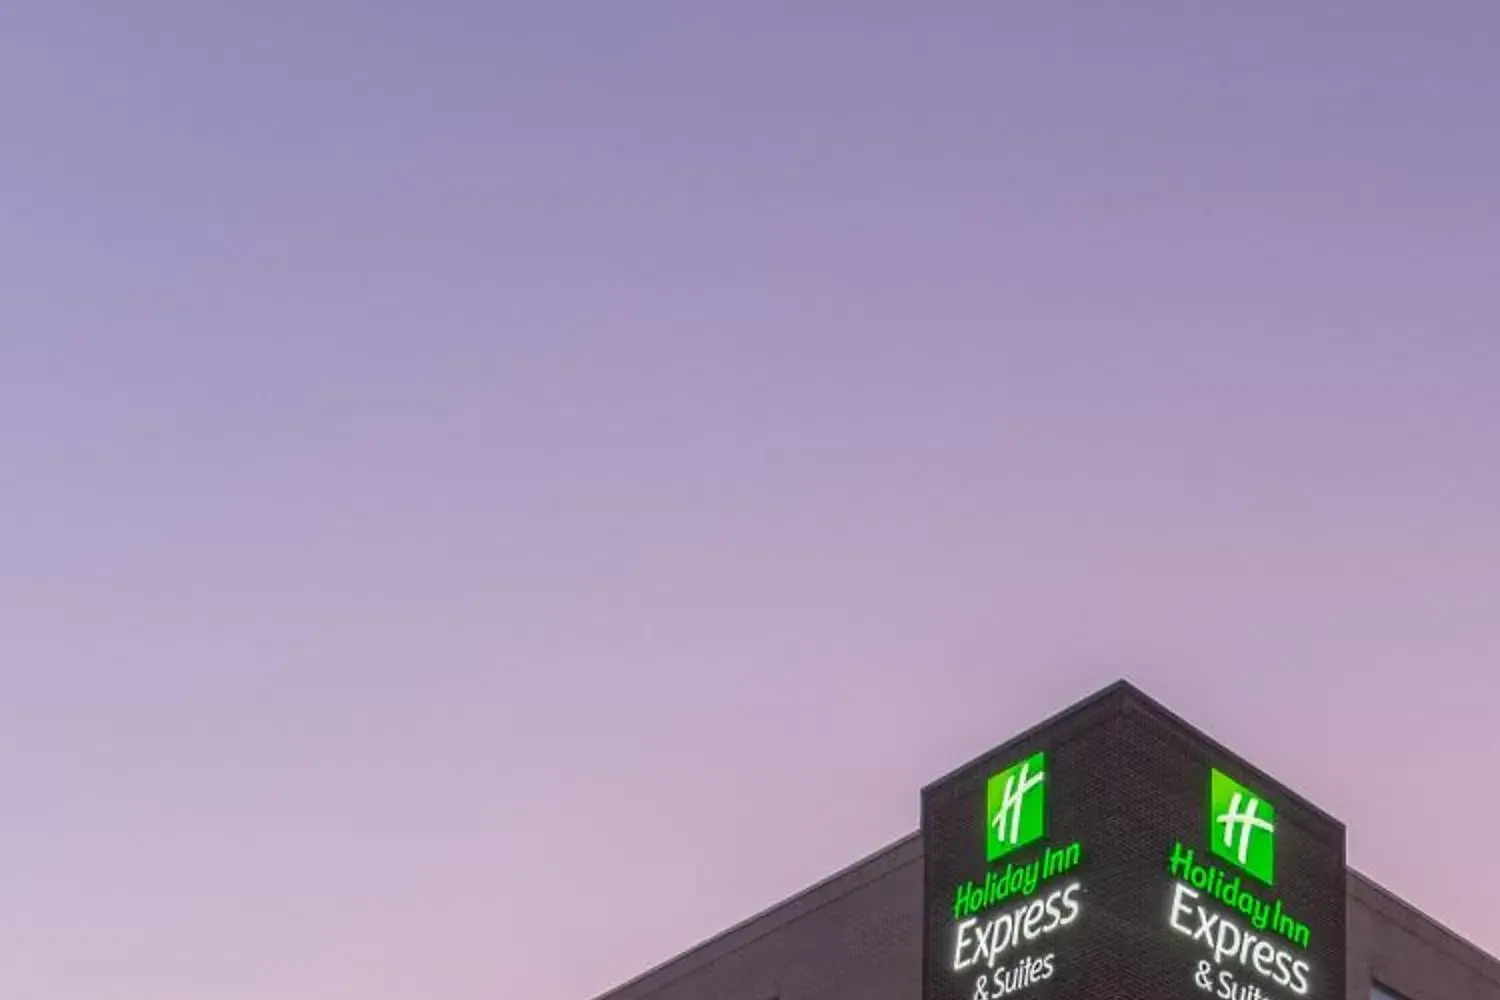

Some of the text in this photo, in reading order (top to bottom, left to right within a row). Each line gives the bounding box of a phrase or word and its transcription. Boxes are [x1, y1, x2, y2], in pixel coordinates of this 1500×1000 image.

[954, 842, 1081, 919] Holiday Inn
[1170, 842, 1311, 948] Holiday Inn
[953, 882, 1081, 971] Express
[1169, 882, 1310, 995] Express
[991, 953, 1055, 999] Suites
[1194, 959, 1213, 992] &
